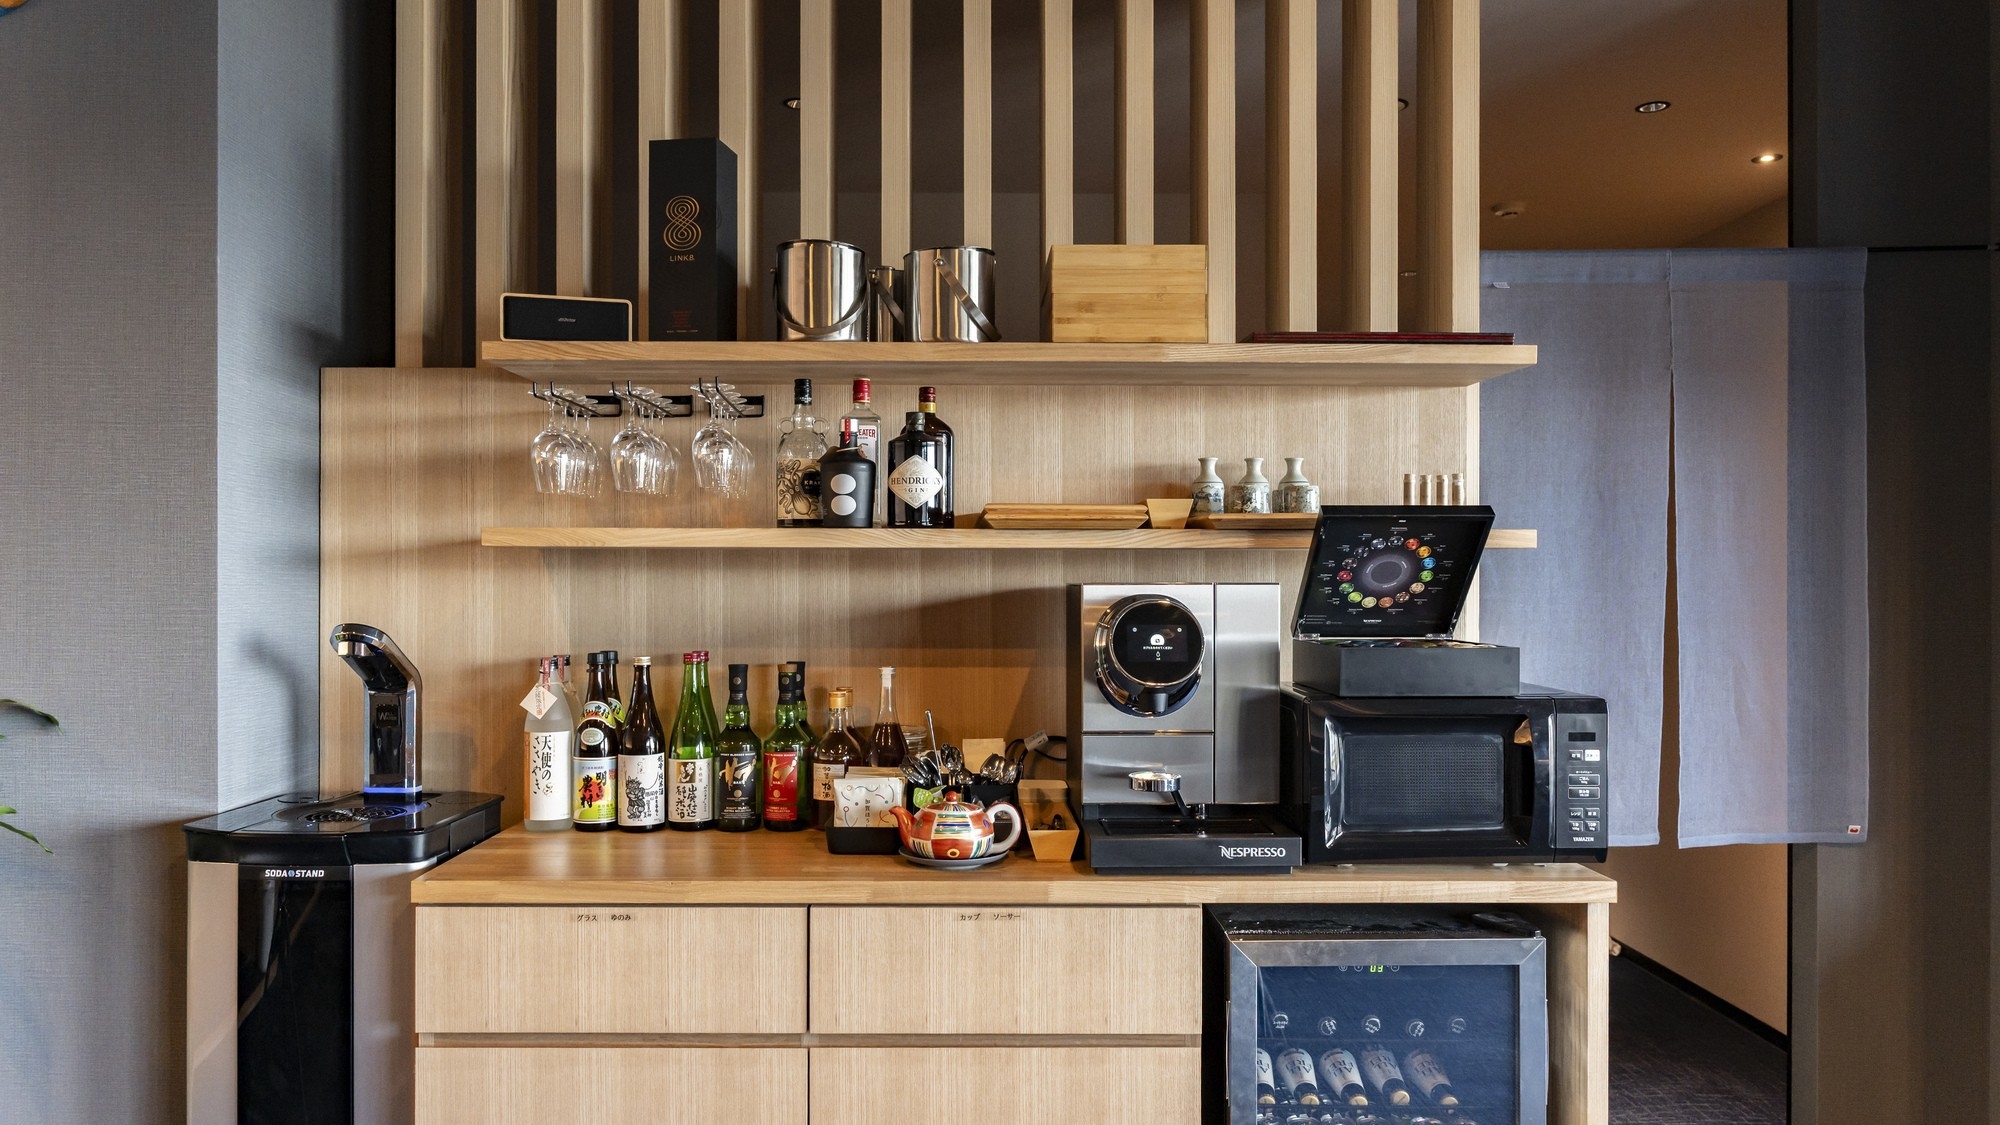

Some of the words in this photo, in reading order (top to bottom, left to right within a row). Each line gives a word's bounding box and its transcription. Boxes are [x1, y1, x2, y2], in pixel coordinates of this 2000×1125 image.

[858, 428, 876, 438] EATER
[541, 734, 552, 781] 天使の
[578, 774, 593, 809] 農村
[686, 783, 698, 818] 山廃仕込
[1218, 845, 1287, 860] NESPRESSO
[264, 869, 288, 878] SODA
[295, 869, 325, 878] STAND
[577, 914, 598, 922] グラス
[960, 913, 981, 921] カップ
[993, 913, 1021, 921] ソーサー
